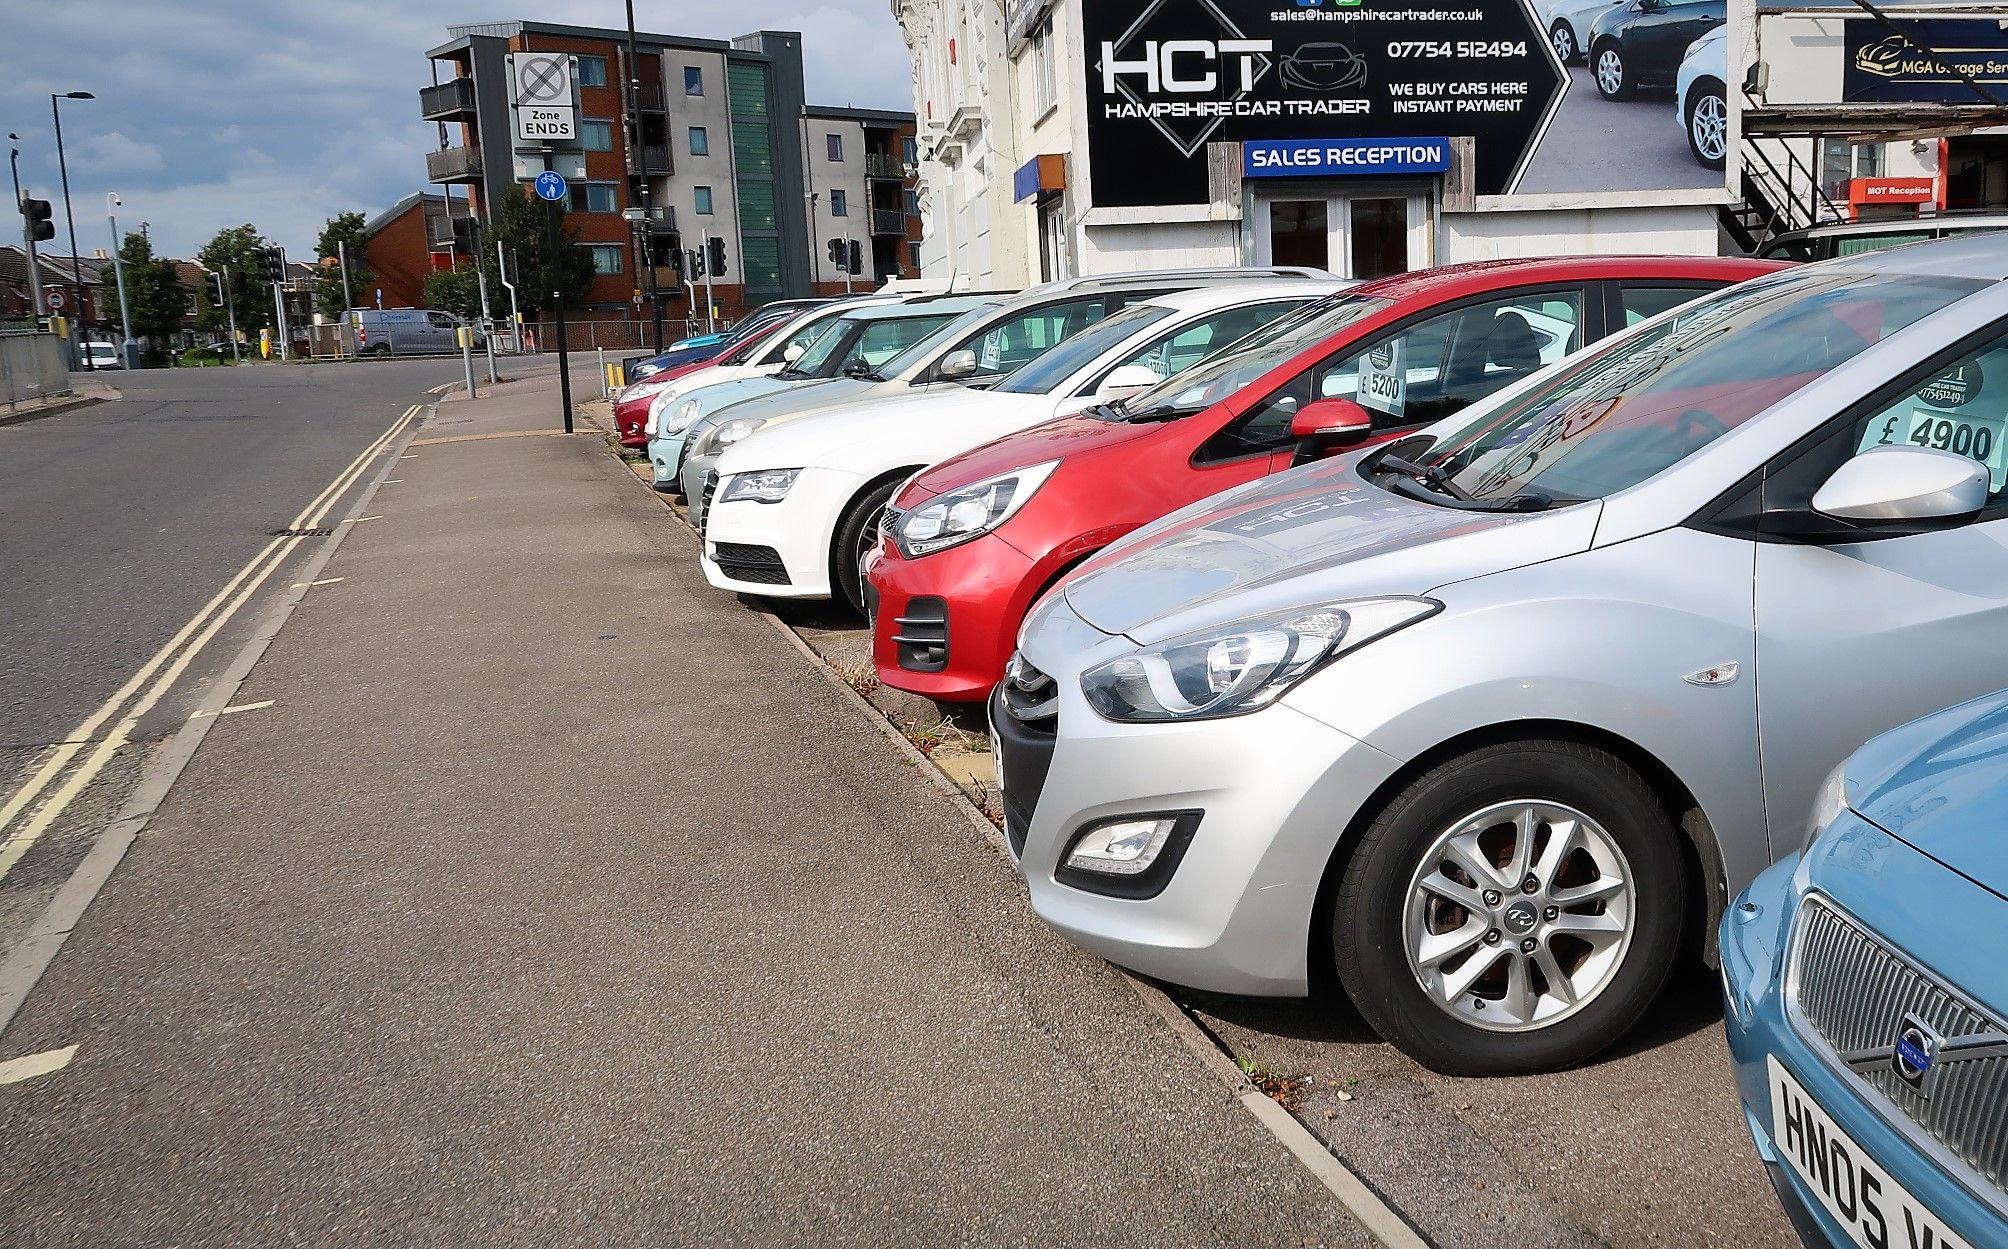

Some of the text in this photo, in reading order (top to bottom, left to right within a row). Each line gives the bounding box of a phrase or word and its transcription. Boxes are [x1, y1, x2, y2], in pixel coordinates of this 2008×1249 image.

[1270, 8, 1483, 23] sales@hampshirecartrader.co.uk
[1387, 41, 1528, 58] 07754 512494
[1101, 39, 1273, 94] HCT
[1901, 61, 1934, 74] MGA
[1986, 61, 2008, 74] Ser
[1389, 81, 1528, 96] WE BUY CARS HERE
[1105, 100, 1370, 119] HAMPSHIRE CAR TRADER
[1393, 99, 1523, 113] INSTANT PAYMENT
[532, 110, 560, 120] Zone
[525, 123, 569, 135] ENDS
[1251, 145, 1441, 168] SALES RECEPTION
[1867, 186, 1931, 197] MOT Reception
[1371, 373, 1399, 399] 5200
[1878, 416, 1992, 461] £ 4900
[1781, 1080, 1888, 1249] HN05
